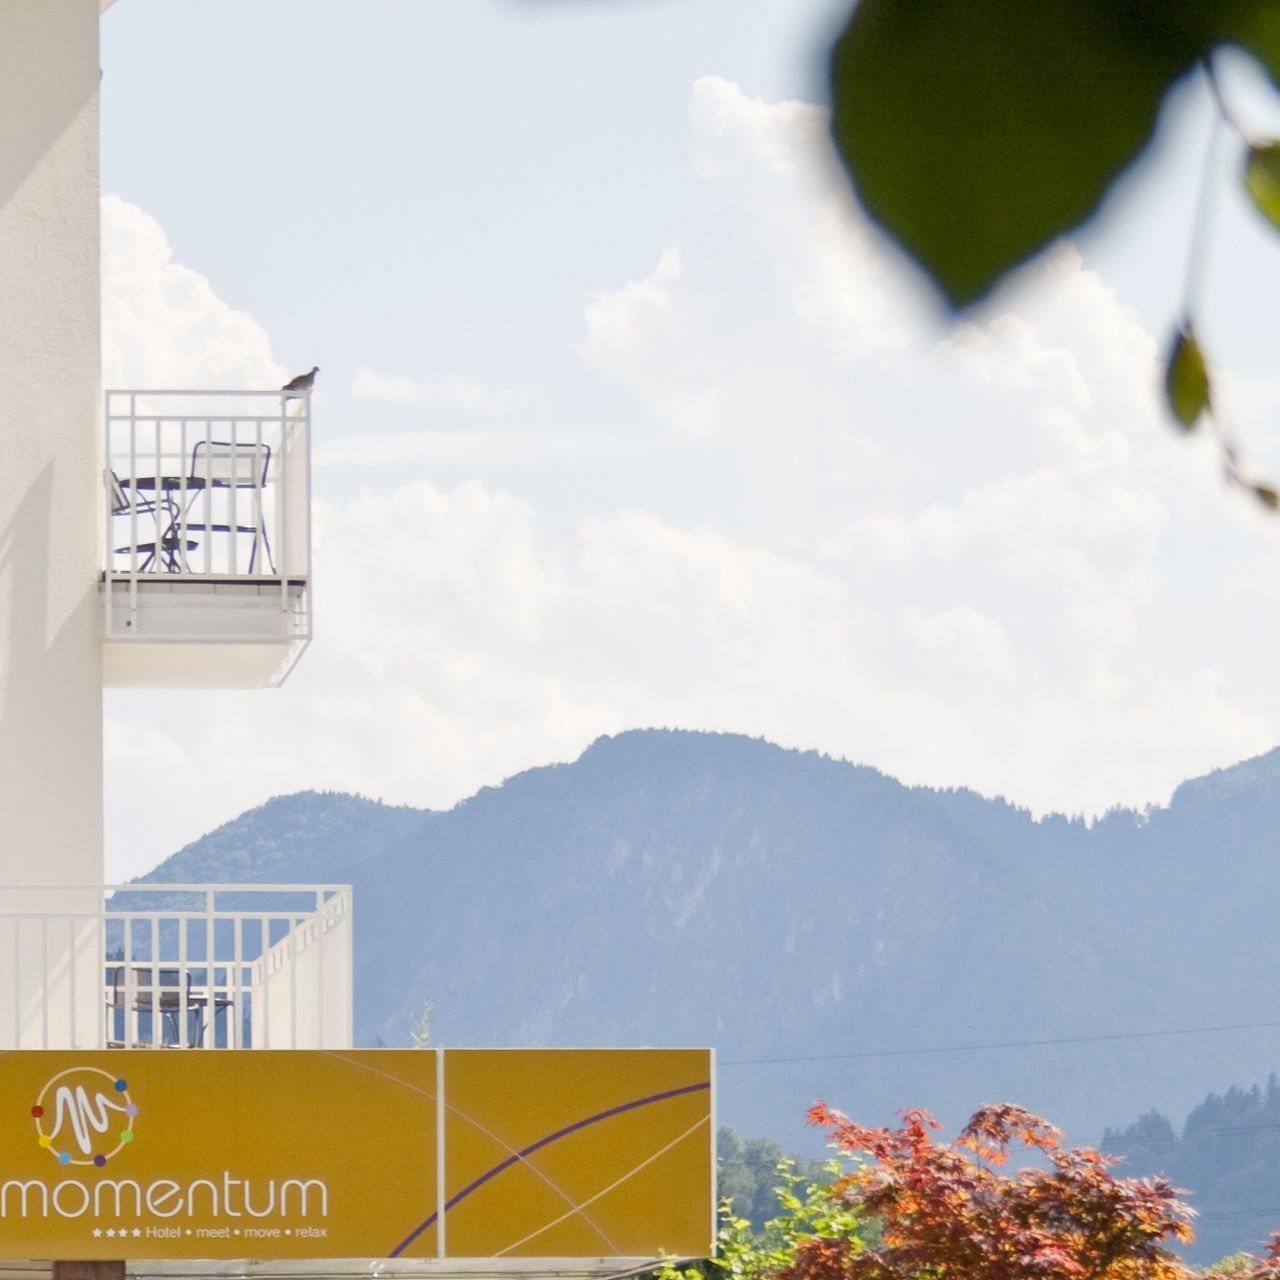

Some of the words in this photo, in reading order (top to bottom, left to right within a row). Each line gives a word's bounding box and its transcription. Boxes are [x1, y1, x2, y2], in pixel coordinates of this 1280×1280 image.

[1, 1171, 327, 1217] momentum
[146, 1226, 181, 1238] Hotel
[196, 1227, 230, 1238] meet
[244, 1228, 280, 1238] move
[295, 1226, 328, 1238] relax
